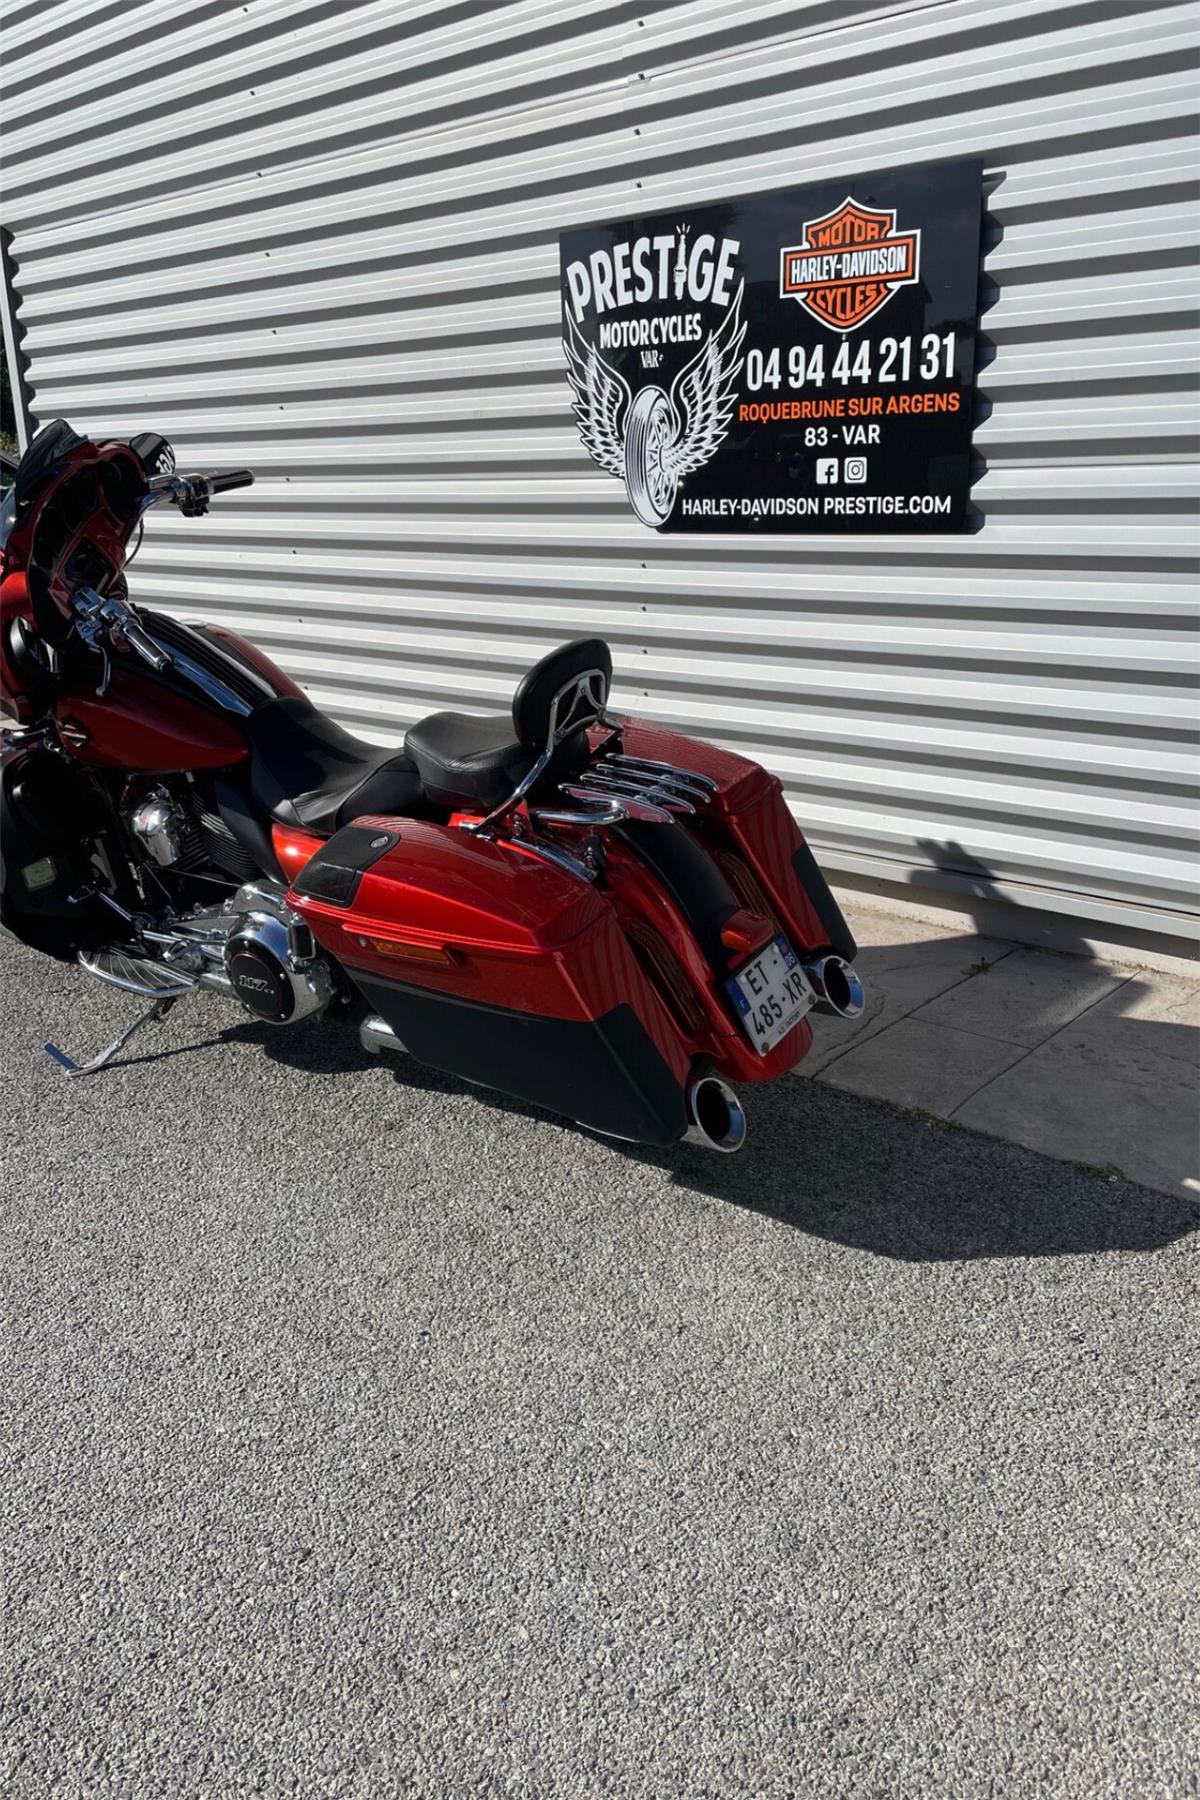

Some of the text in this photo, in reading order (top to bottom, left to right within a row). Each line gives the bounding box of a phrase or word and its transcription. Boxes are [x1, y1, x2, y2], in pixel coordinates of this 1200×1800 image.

[819, 214, 879, 247] MOTOR
[566, 233, 741, 323] PRESTIGE
[791, 245, 907, 285] HARLEY-DAVIDSON
[816, 283, 877, 320] CYCLES
[600, 313, 702, 349] MOTORCYCLES
[641, 350, 659, 368] VAR
[747, 332, 955, 391] 04 94 44 21 31
[739, 392, 960, 424] ROQUEBRUNE SUR ARGENS
[804, 427, 829, 447] 83
[842, 424, 881, 445] VAR
[682, 496, 951, 516] HARLEY-DAVIDSON PRESTIGE.COM
